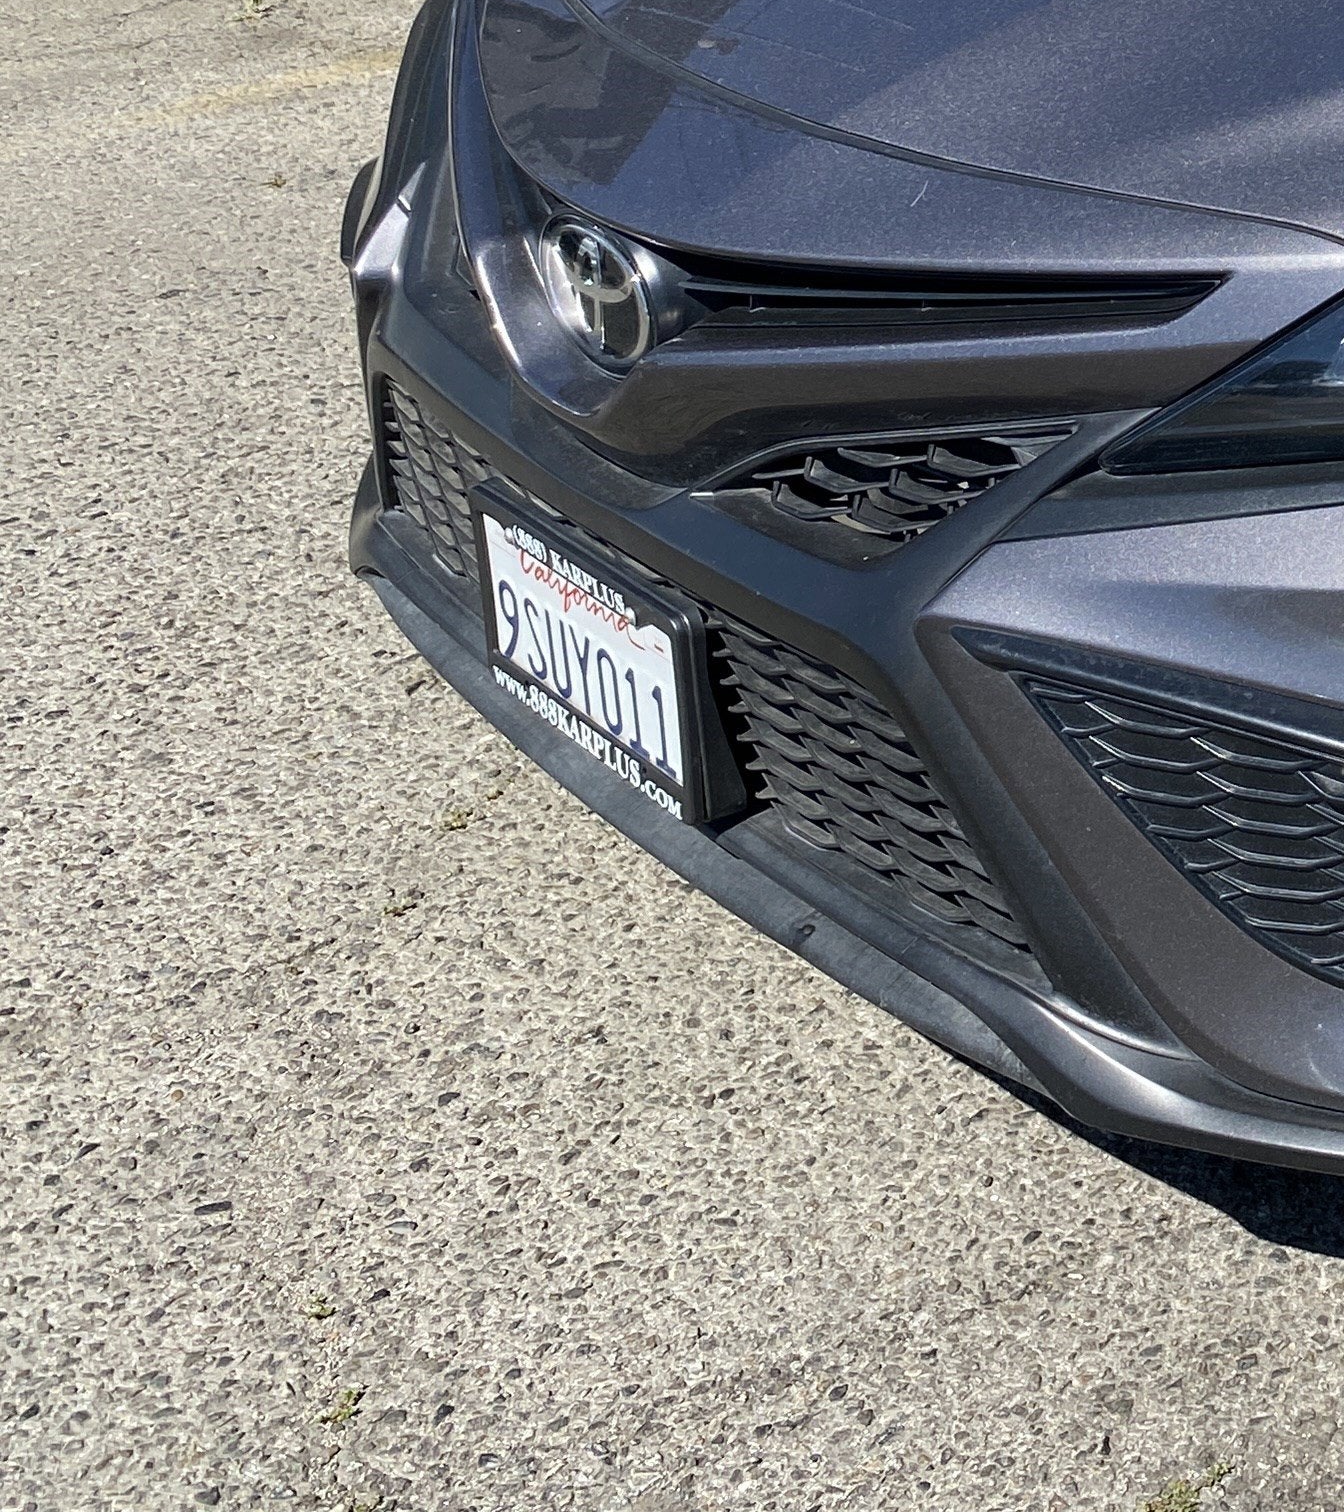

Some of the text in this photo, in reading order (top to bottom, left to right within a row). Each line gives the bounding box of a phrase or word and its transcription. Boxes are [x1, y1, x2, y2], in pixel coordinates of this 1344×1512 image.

[512, 524, 627, 614] (888) KARPLUS
[492, 664, 683, 821] www.888KARPLUS.COM
[499, 579, 677, 779] 9SUY011
